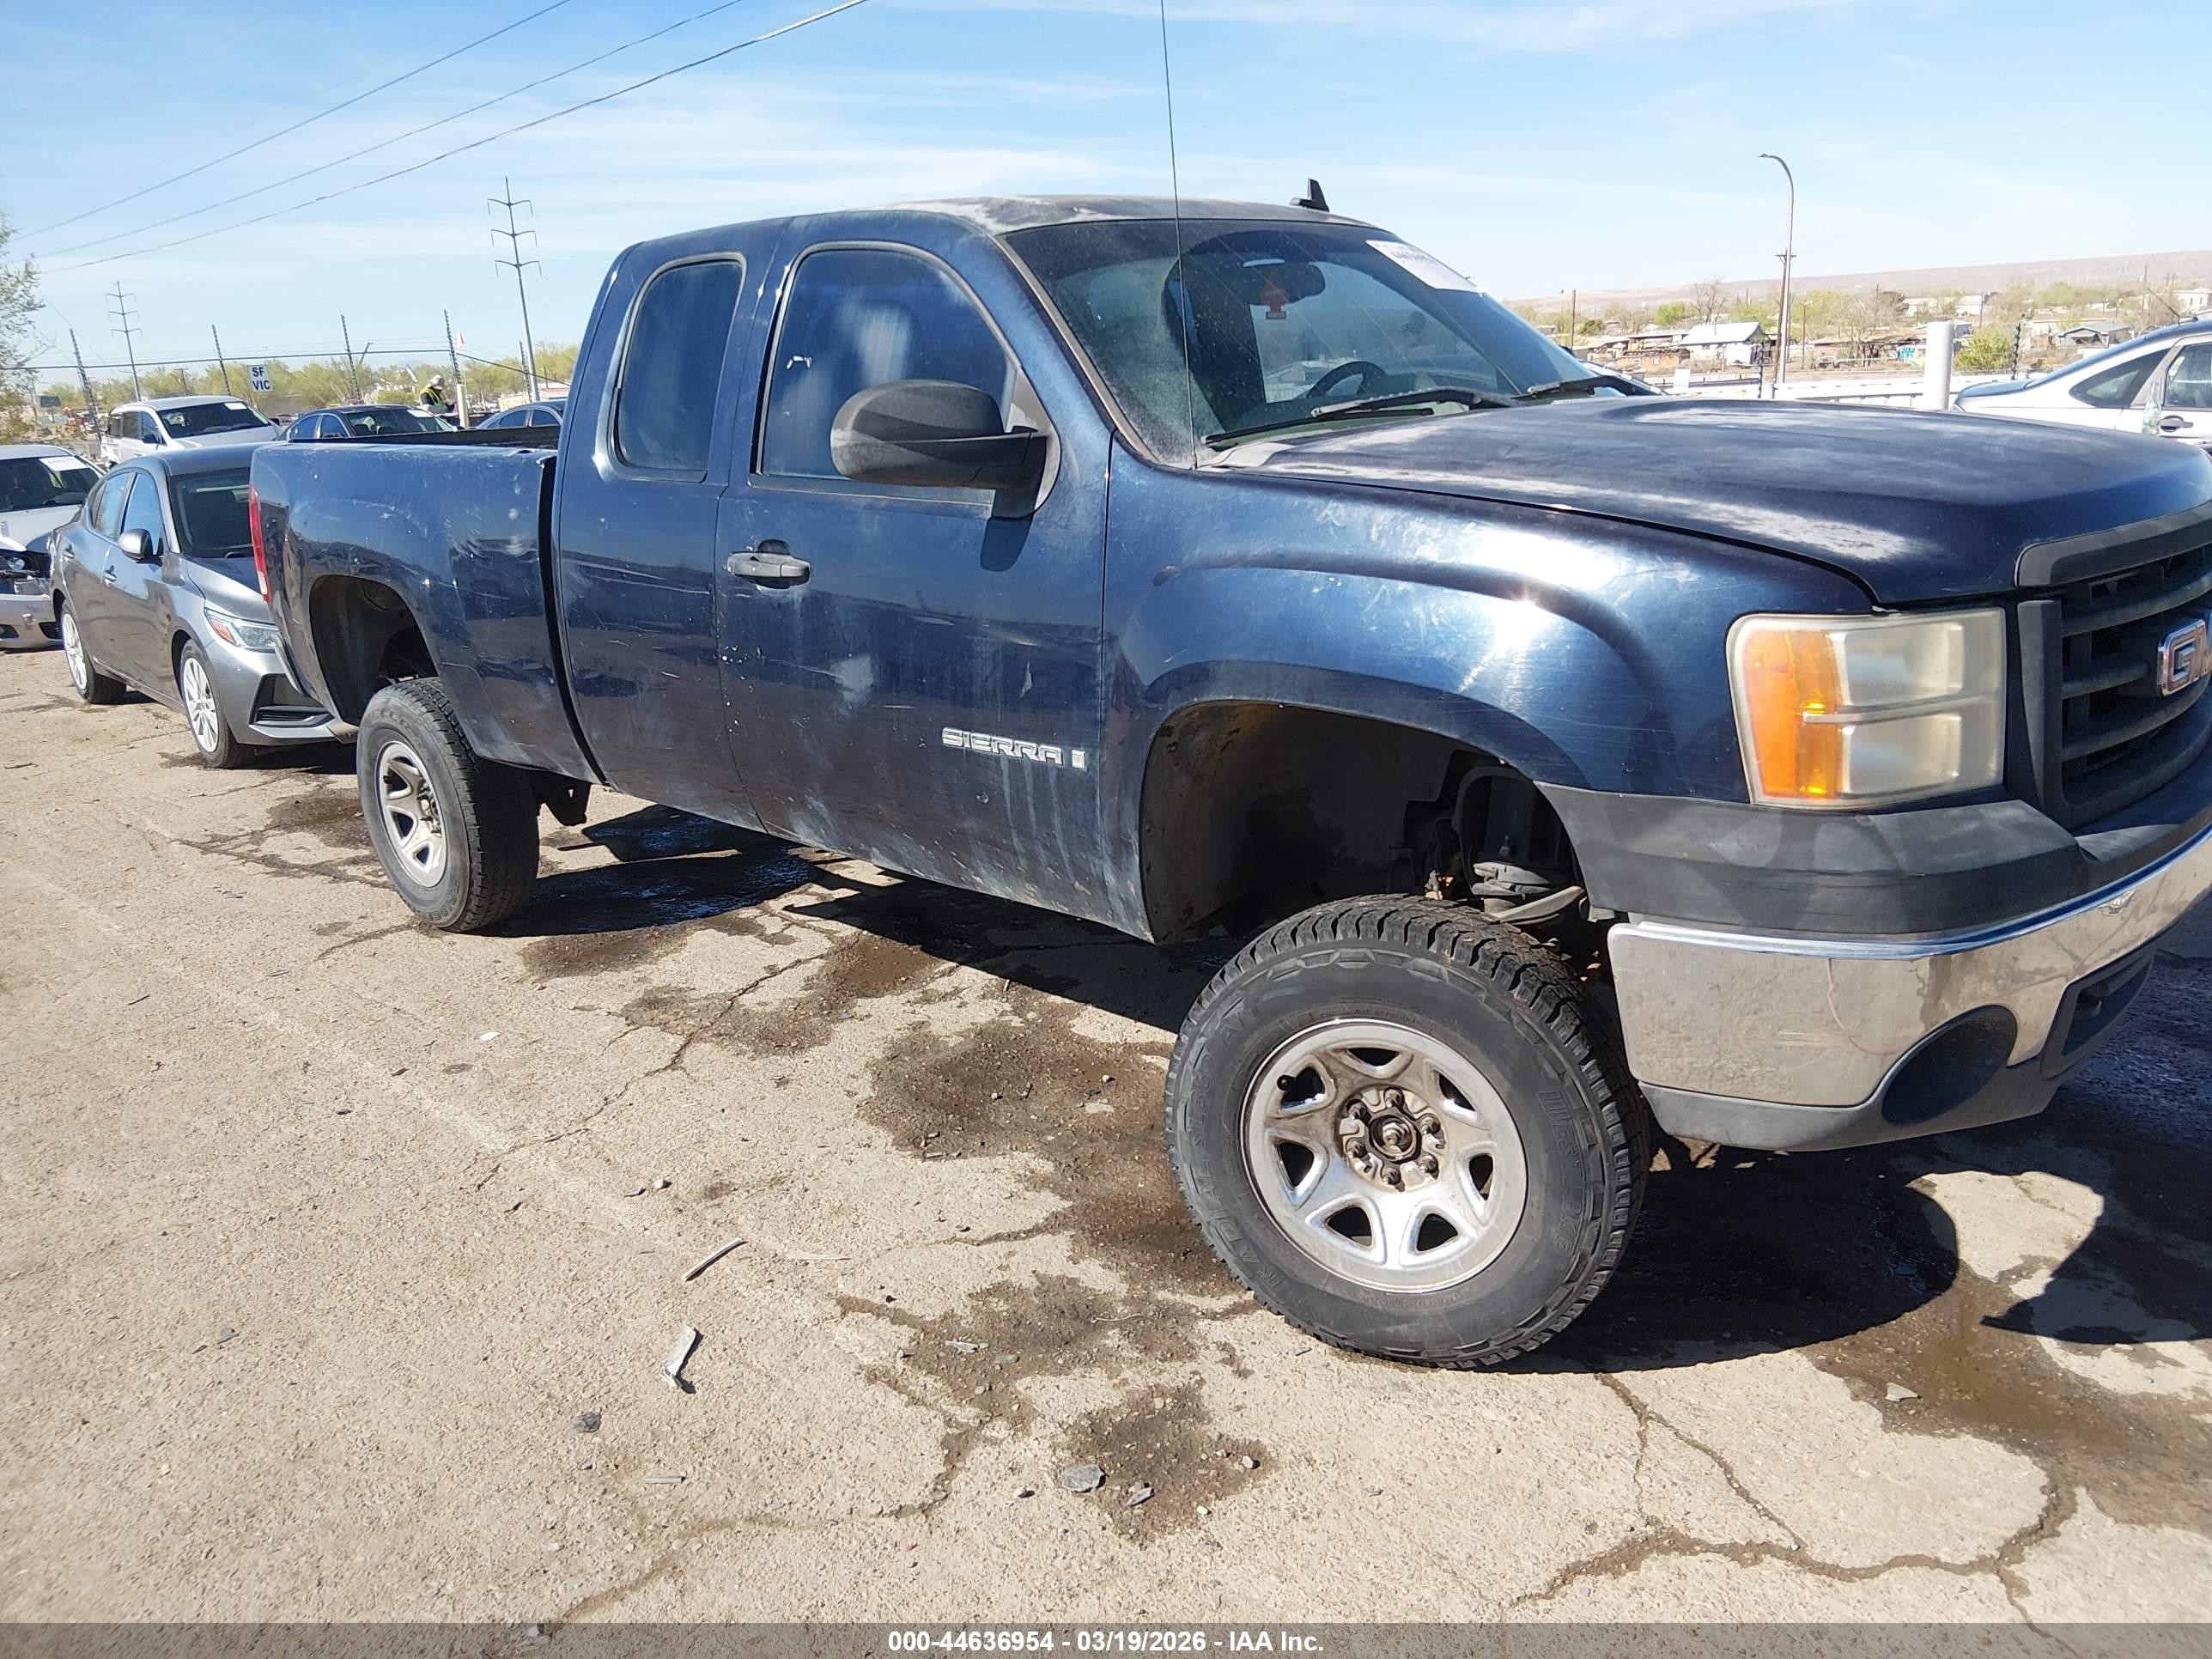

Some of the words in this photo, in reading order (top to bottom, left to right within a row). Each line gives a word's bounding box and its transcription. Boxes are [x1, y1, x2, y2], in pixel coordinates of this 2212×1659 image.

[252, 367, 264, 377] SF
[252, 380, 270, 391] VIC
[942, 726, 1063, 766] SIERRA
[1536, 1089, 1583, 1255] WESTLAKE
[1194, 1160, 1283, 1290] RADIAL
